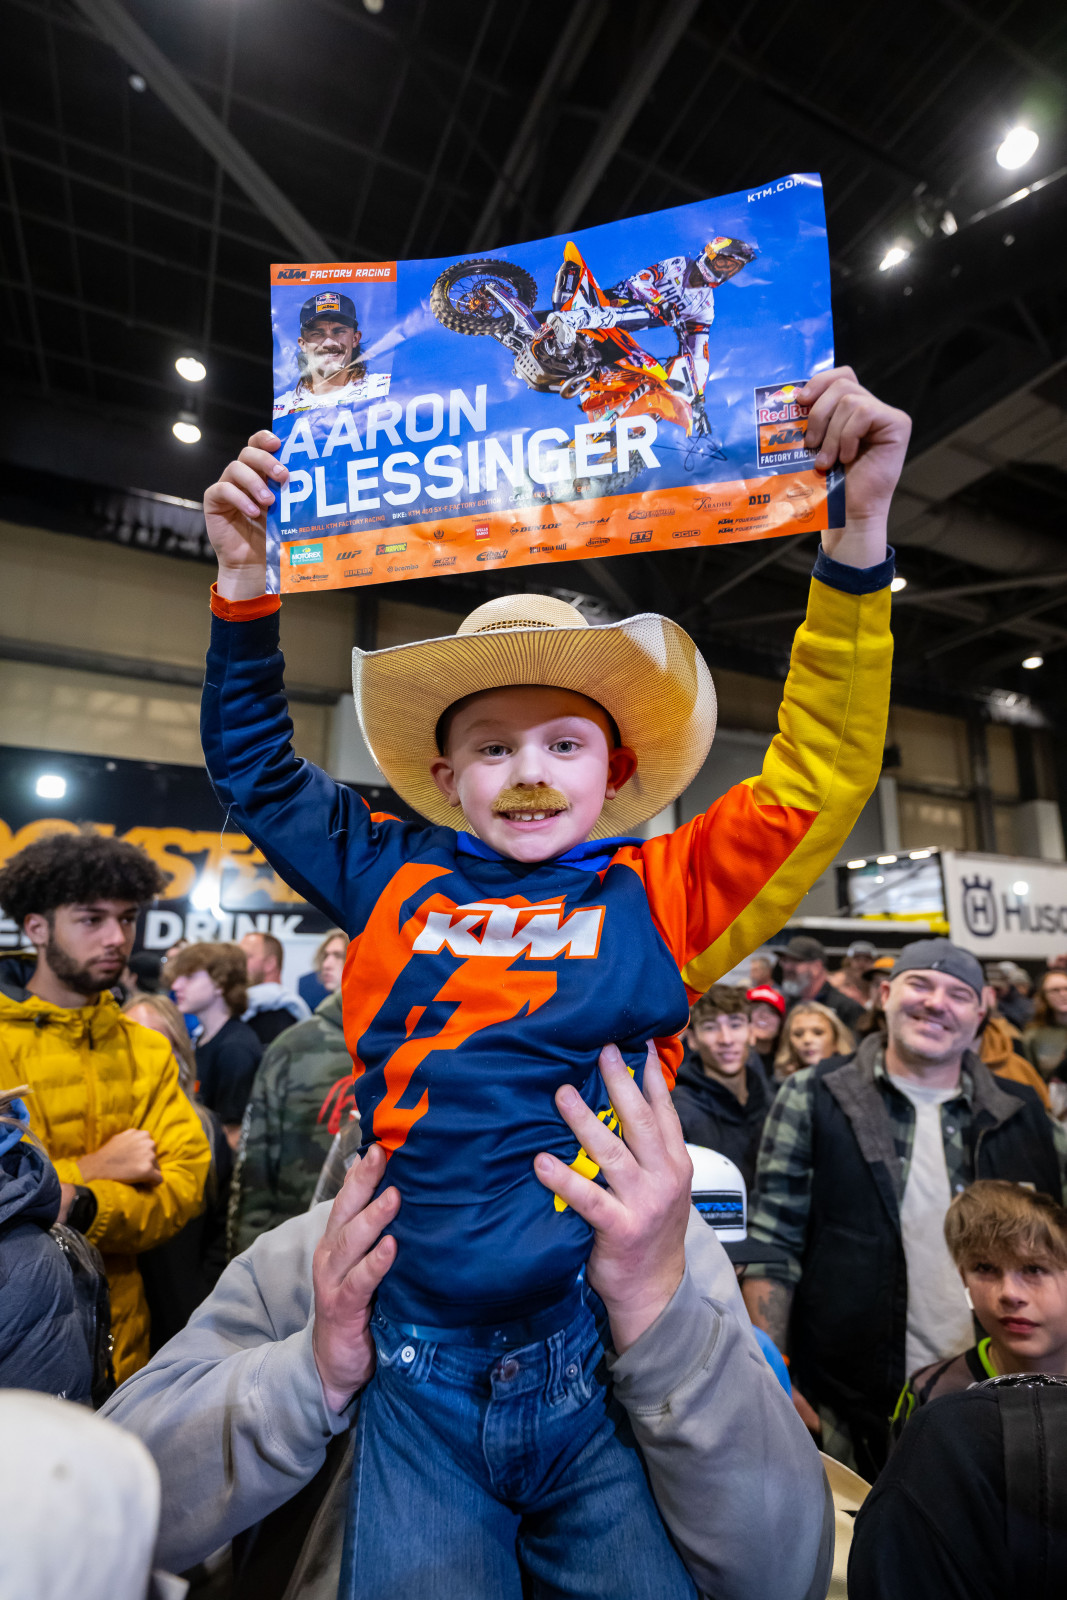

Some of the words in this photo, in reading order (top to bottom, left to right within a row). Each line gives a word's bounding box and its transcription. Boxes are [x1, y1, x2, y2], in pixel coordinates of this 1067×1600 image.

[747, 179, 804, 203] KTM.COM
[277, 269, 307, 279] KTM
[310, 269, 353, 279] FACTORY
[355, 268, 391, 277] RACING
[280, 384, 488, 464] AARON
[760, 404, 788, 424] Red
[280, 415, 661, 522] PLESSINGER
[760, 452, 791, 465] FACTORY
[326, 522, 338, 530] KTM
[338, 518, 363, 527] FACTORY
[364, 514, 386, 524] RACING
[408, 509, 420, 517] KTM
[434, 505, 448, 513] SX-F
[449, 501, 476, 511] FACTORY
[477, 497, 502, 506] EDITION
[520, 523, 562, 533] DUNLOP
[631, 531, 652, 540] ETS
[672, 530, 700, 538] OGIO
[291, 550, 321, 560] MOTOREX
[144, 911, 304, 949] DRINK
[412, 902, 603, 958] KTM
